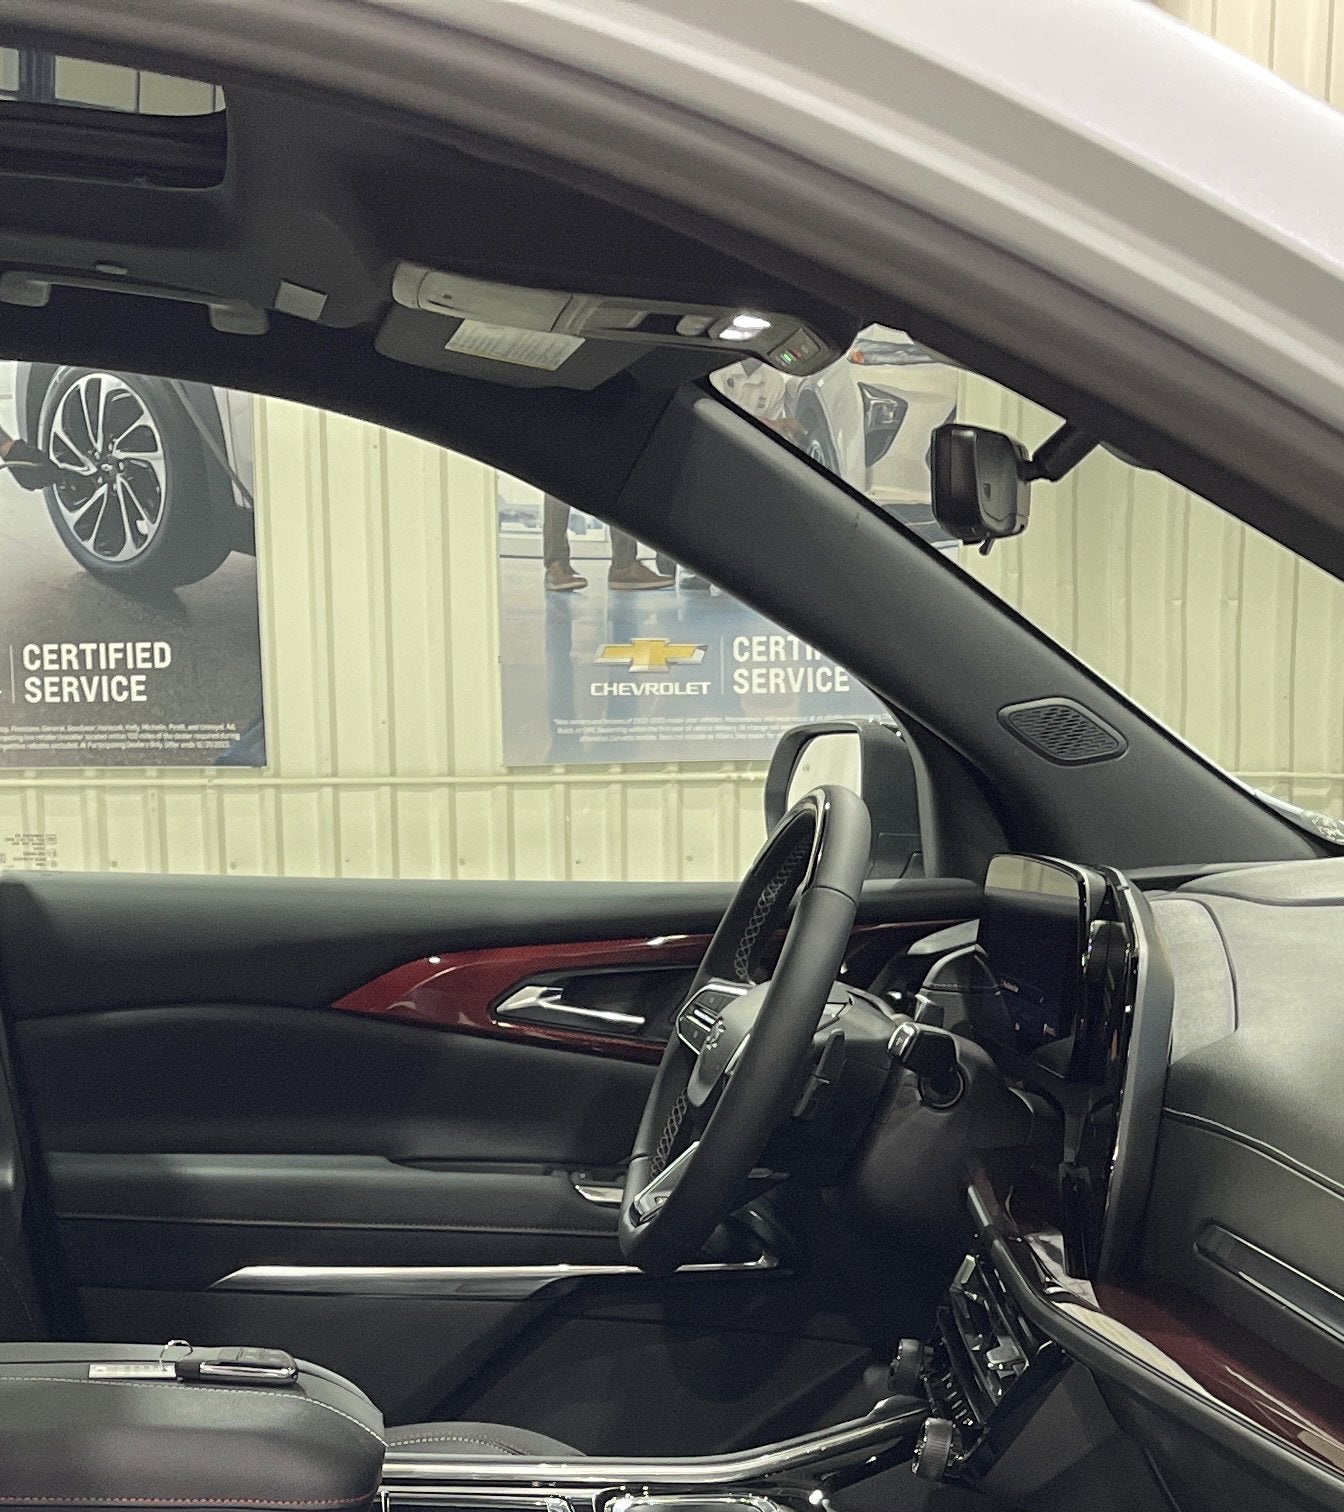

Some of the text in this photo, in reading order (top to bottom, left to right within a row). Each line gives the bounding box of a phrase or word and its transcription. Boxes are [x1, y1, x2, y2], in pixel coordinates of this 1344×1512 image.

[22, 641, 173, 671] CERTIFIED
[24, 674, 149, 704] SERVICE
[590, 681, 712, 697] CHEVROLET
[732, 666, 851, 694] SERVICE
